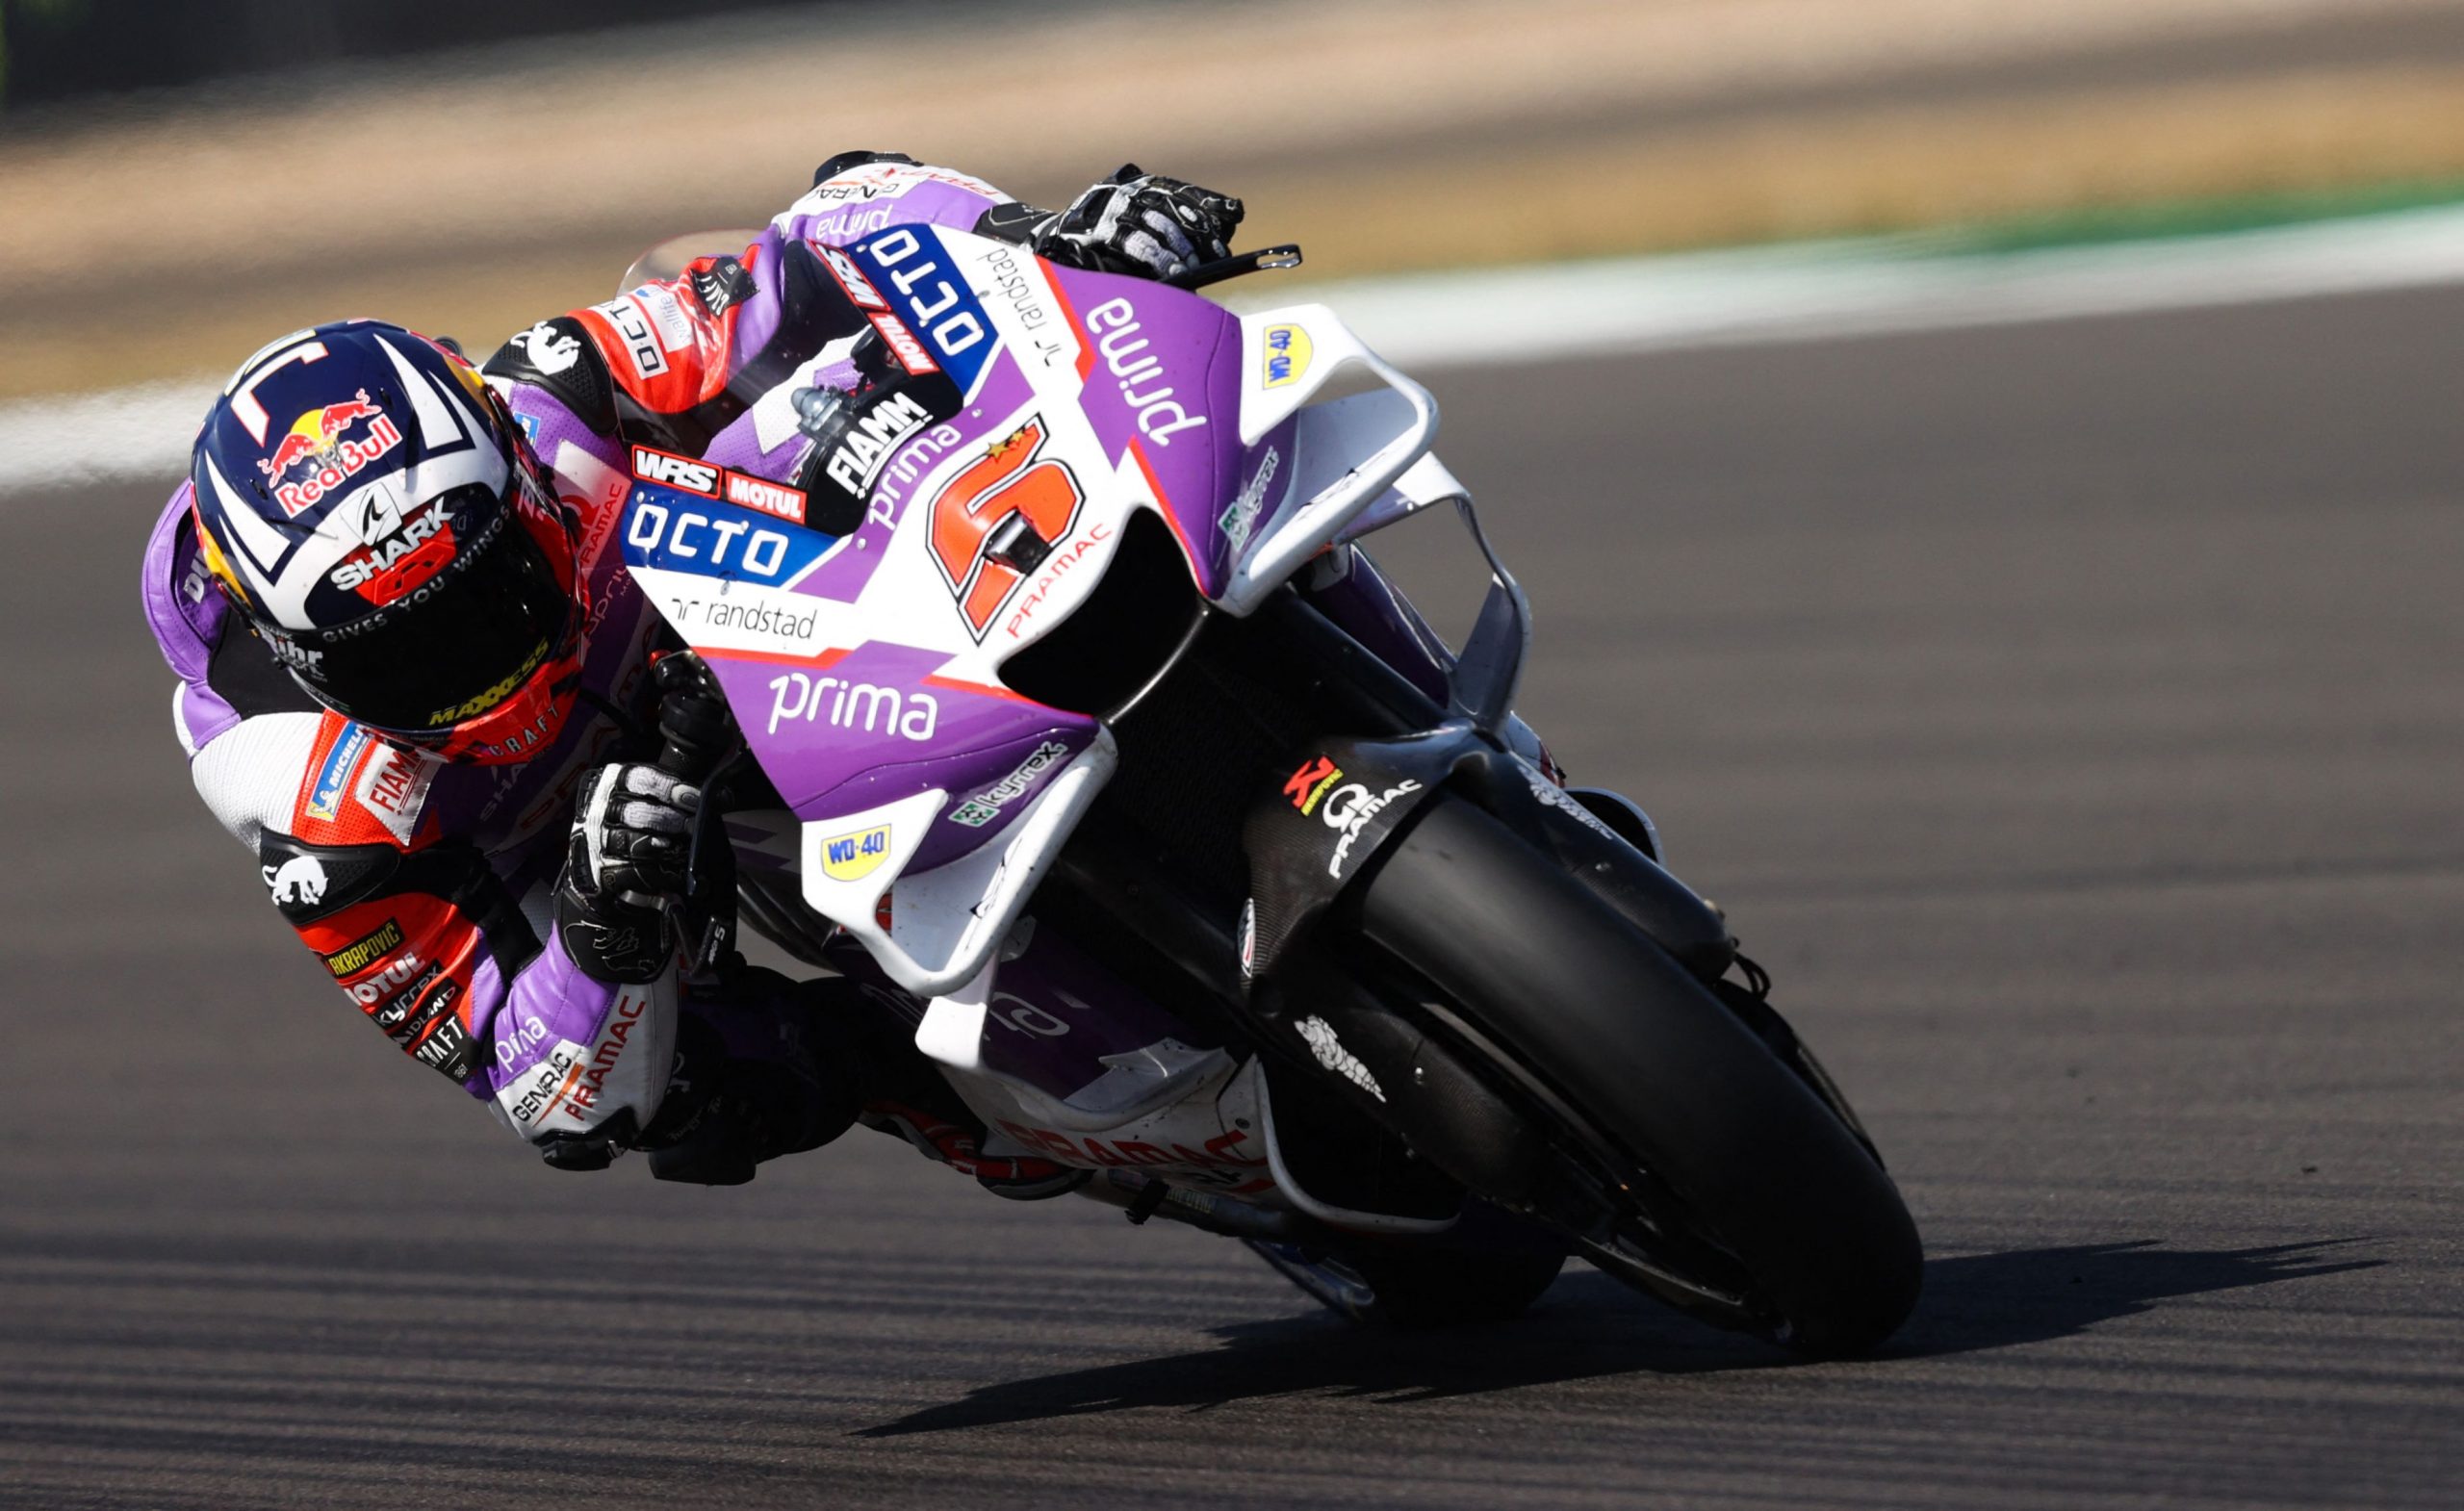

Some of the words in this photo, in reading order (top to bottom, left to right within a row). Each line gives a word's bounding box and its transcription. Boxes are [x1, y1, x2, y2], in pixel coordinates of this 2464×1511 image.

[870, 229, 985, 356] OCTO
[976, 247, 1047, 331] randstad
[874, 314, 936, 370] MOTUL
[1086, 296, 1207, 447] prima
[1269, 329, 1292, 383] WD-40
[341, 415, 402, 475] Bull
[635, 449, 717, 493] WRS
[826, 391, 929, 496] FIAMM
[868, 423, 962, 530] prima
[730, 476, 803, 519] MOTUL
[322, 613, 388, 642] GIVES
[398, 576, 446, 612] YOU
[453, 506, 510, 573] WINGS
[330, 496, 456, 591] SHARK
[628, 503, 789, 576] OCTO
[1007, 523, 1113, 639] PRAMAC
[706, 600, 817, 640] randstad
[488, 704, 560, 756] CRAFT
[767, 672, 938, 741] prima
[329, 727, 365, 788] MICHELI
[977, 742, 1064, 807] kyrrex
[827, 830, 886, 865] WD-40
[1328, 778, 1424, 880] PRAMAC
[564, 995, 647, 1121] PRAMAC
